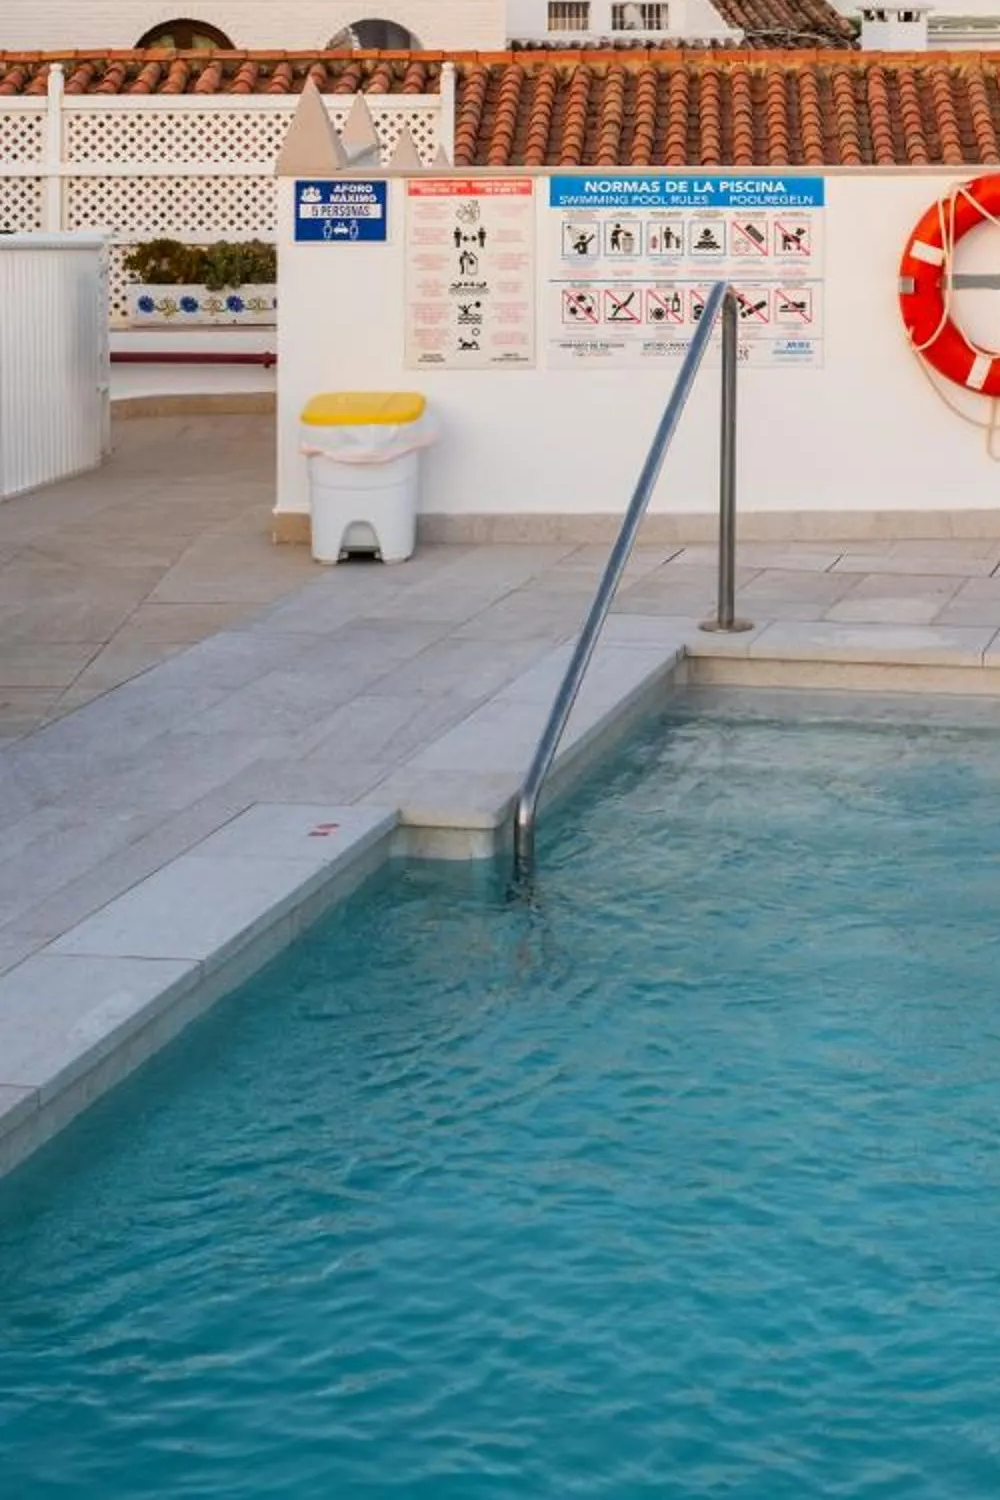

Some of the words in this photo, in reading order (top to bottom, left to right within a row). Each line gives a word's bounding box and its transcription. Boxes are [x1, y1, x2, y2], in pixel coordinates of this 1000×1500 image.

[333, 184, 373, 193] AFORO
[584, 181, 660, 193] NORMAS
[665, 181, 688, 193] DE
[693, 181, 715, 193] LA
[719, 181, 787, 193] PISCINA
[559, 195, 629, 205] SWIMMING
[632, 195, 668, 205] POOL
[671, 195, 709, 205] RULES
[729, 195, 814, 205] POOLREGELN
[320, 205, 370, 217] PERSONAS
